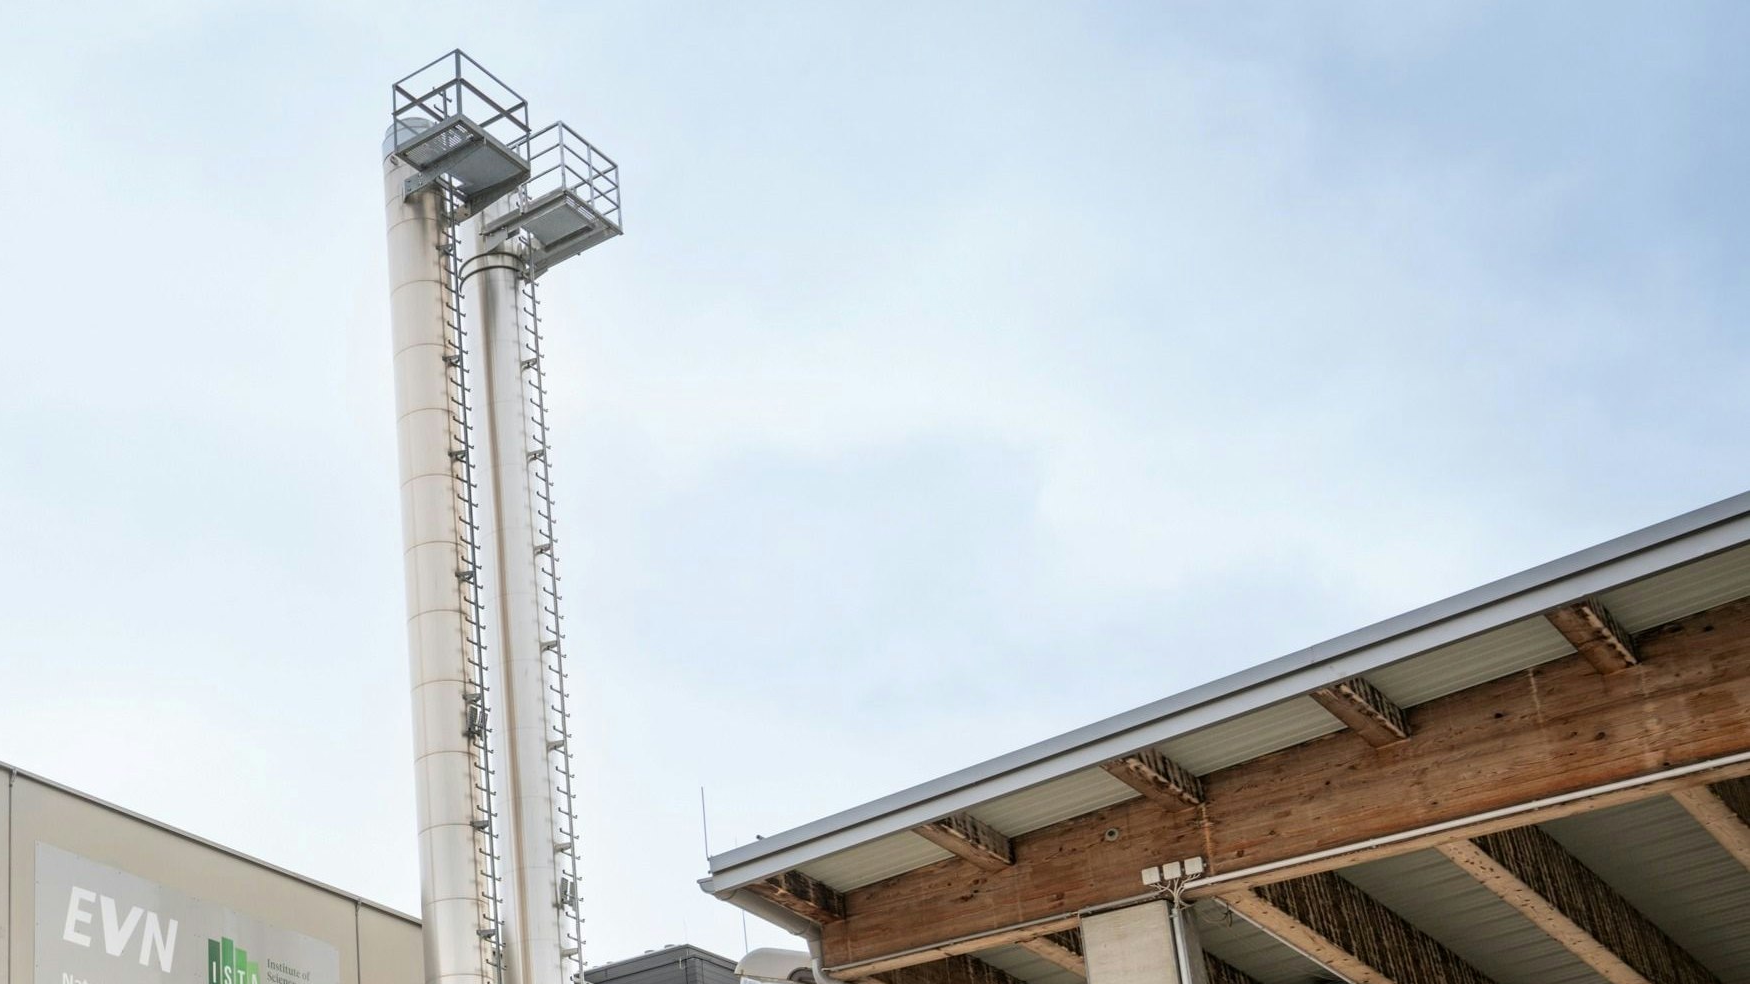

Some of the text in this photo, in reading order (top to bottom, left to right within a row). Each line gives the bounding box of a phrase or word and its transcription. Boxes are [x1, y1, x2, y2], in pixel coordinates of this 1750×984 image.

[62, 886, 179, 974] EVN
[267, 959, 311, 981] Institute of
